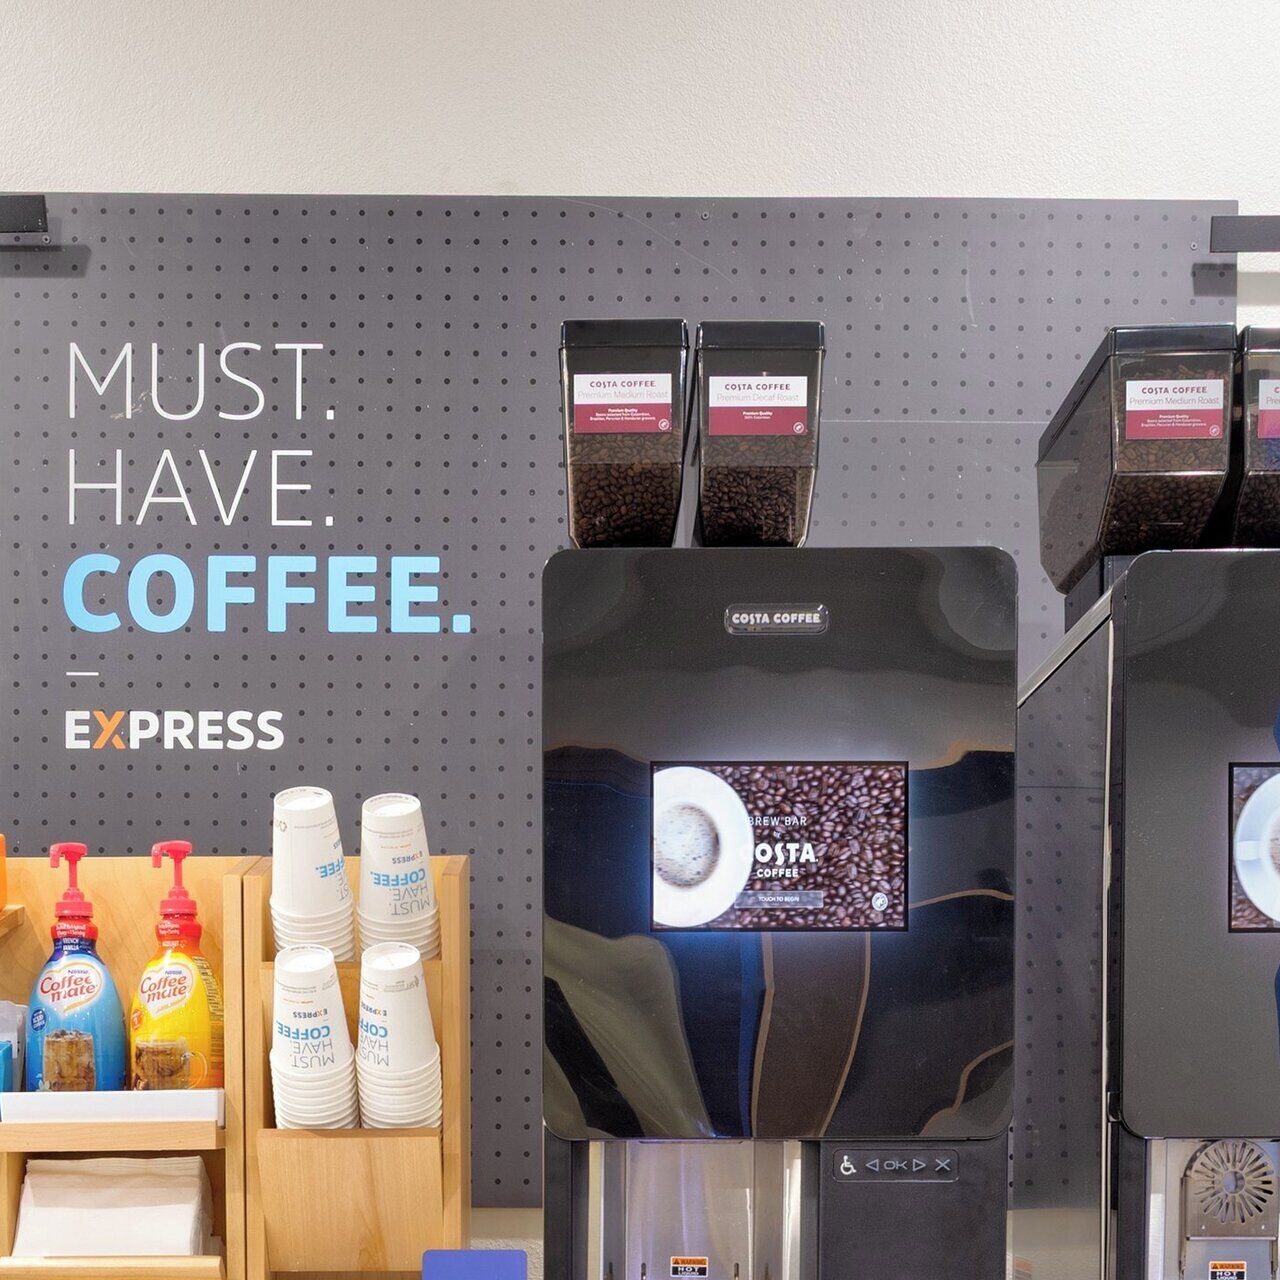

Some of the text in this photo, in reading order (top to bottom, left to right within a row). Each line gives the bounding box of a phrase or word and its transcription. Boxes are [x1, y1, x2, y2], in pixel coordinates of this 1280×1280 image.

[68, 342, 334, 420] MUST.
[590, 380, 656, 389] COSTA COFFEE
[725, 383, 791, 391] COSTA COFFEE
[578, 391, 668, 399] Premium Medium Roast
[717, 393, 799, 401] Premium Decaf Roast
[1142, 386, 1208, 395] COSTA COFFEE
[1130, 397, 1163, 405] Premium
[1198, 396, 1219, 404] Roast
[68, 449, 334, 526] HAVE.
[62, 553, 471, 634] COFFEE.
[732, 613, 821, 625] COSTA COFFEE
[64, 710, 285, 750] EXPRESS
[748, 816, 807, 826] BREW BAR
[755, 842, 815, 866] OSTA
[370, 868, 426, 887] COFFEE.
[756, 868, 799, 878] COFFEE
[389, 881, 428, 901] HAVE.
[389, 895, 431, 916] MUST.
[40, 975, 94, 995] Coffee
[50, 984, 96, 1003] mate
[140, 975, 187, 994] Coffee
[146, 985, 187, 1003] mate
[293, 1008, 328, 1019] EXPRESS
[360, 1047, 389, 1067] MUS
[883, 1160, 908, 1170] OK
